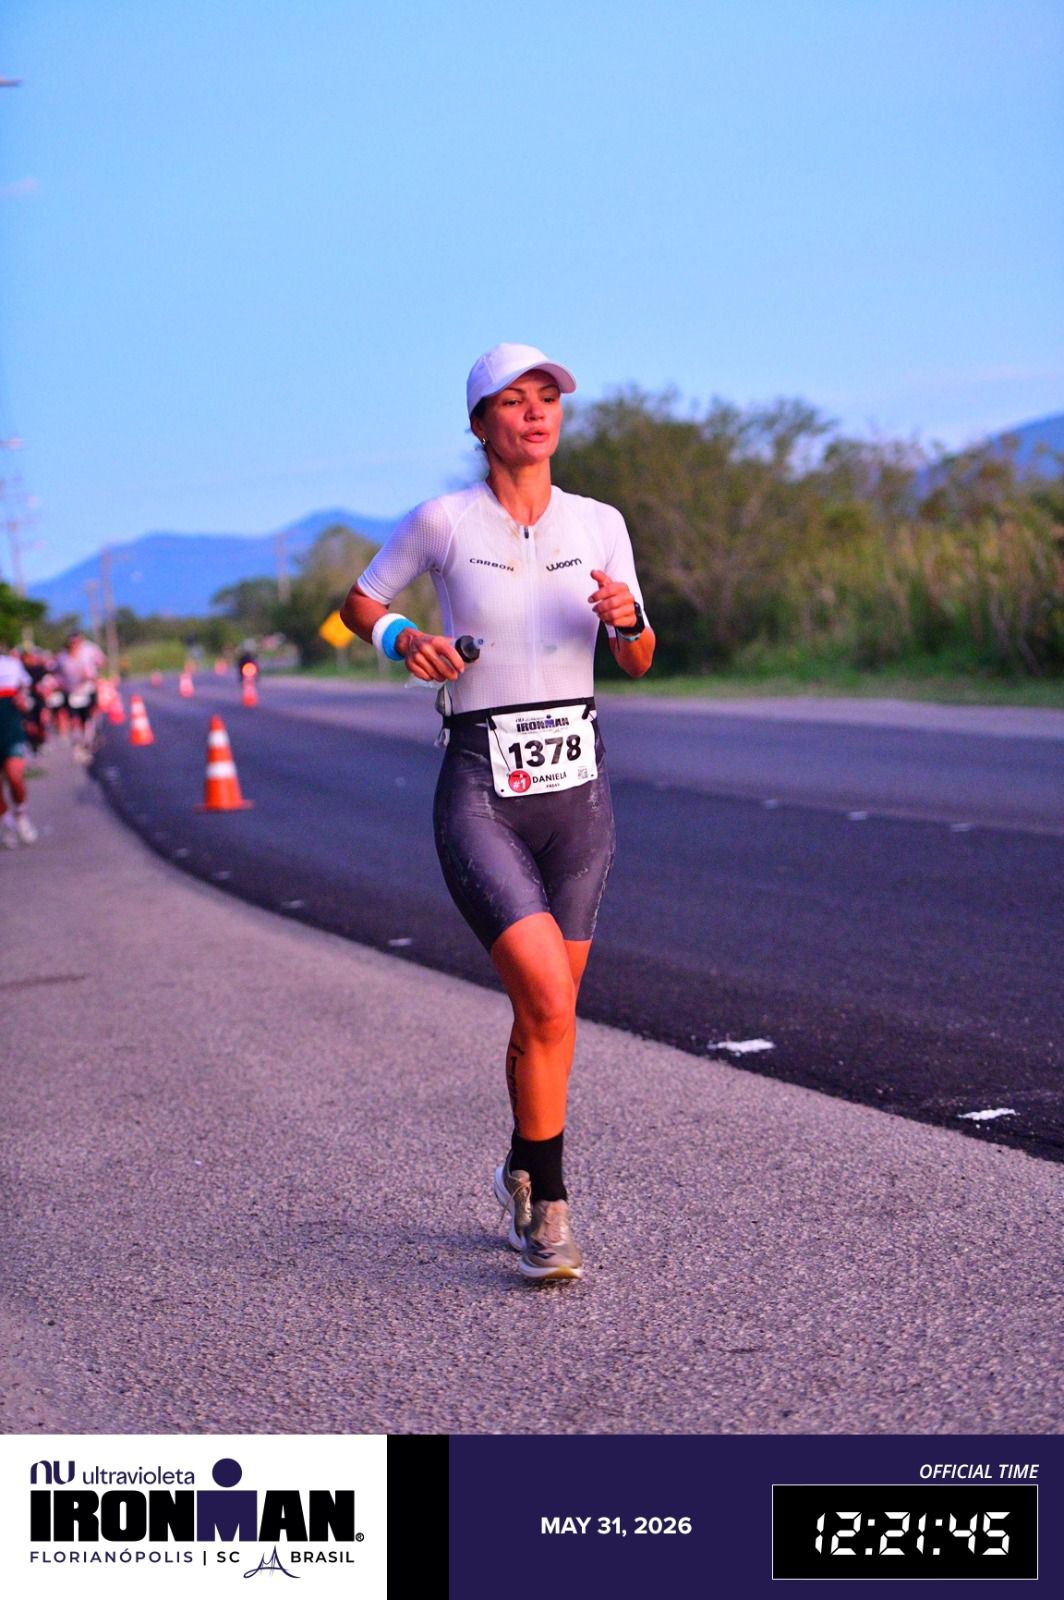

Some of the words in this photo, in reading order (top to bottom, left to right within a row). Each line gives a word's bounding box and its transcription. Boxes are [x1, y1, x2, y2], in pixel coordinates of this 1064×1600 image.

[469, 557, 515, 572] CARBON
[516, 715, 570, 733] IRONMAN
[508, 734, 582, 769] 1378
[532, 771, 567, 784] DANIELA
